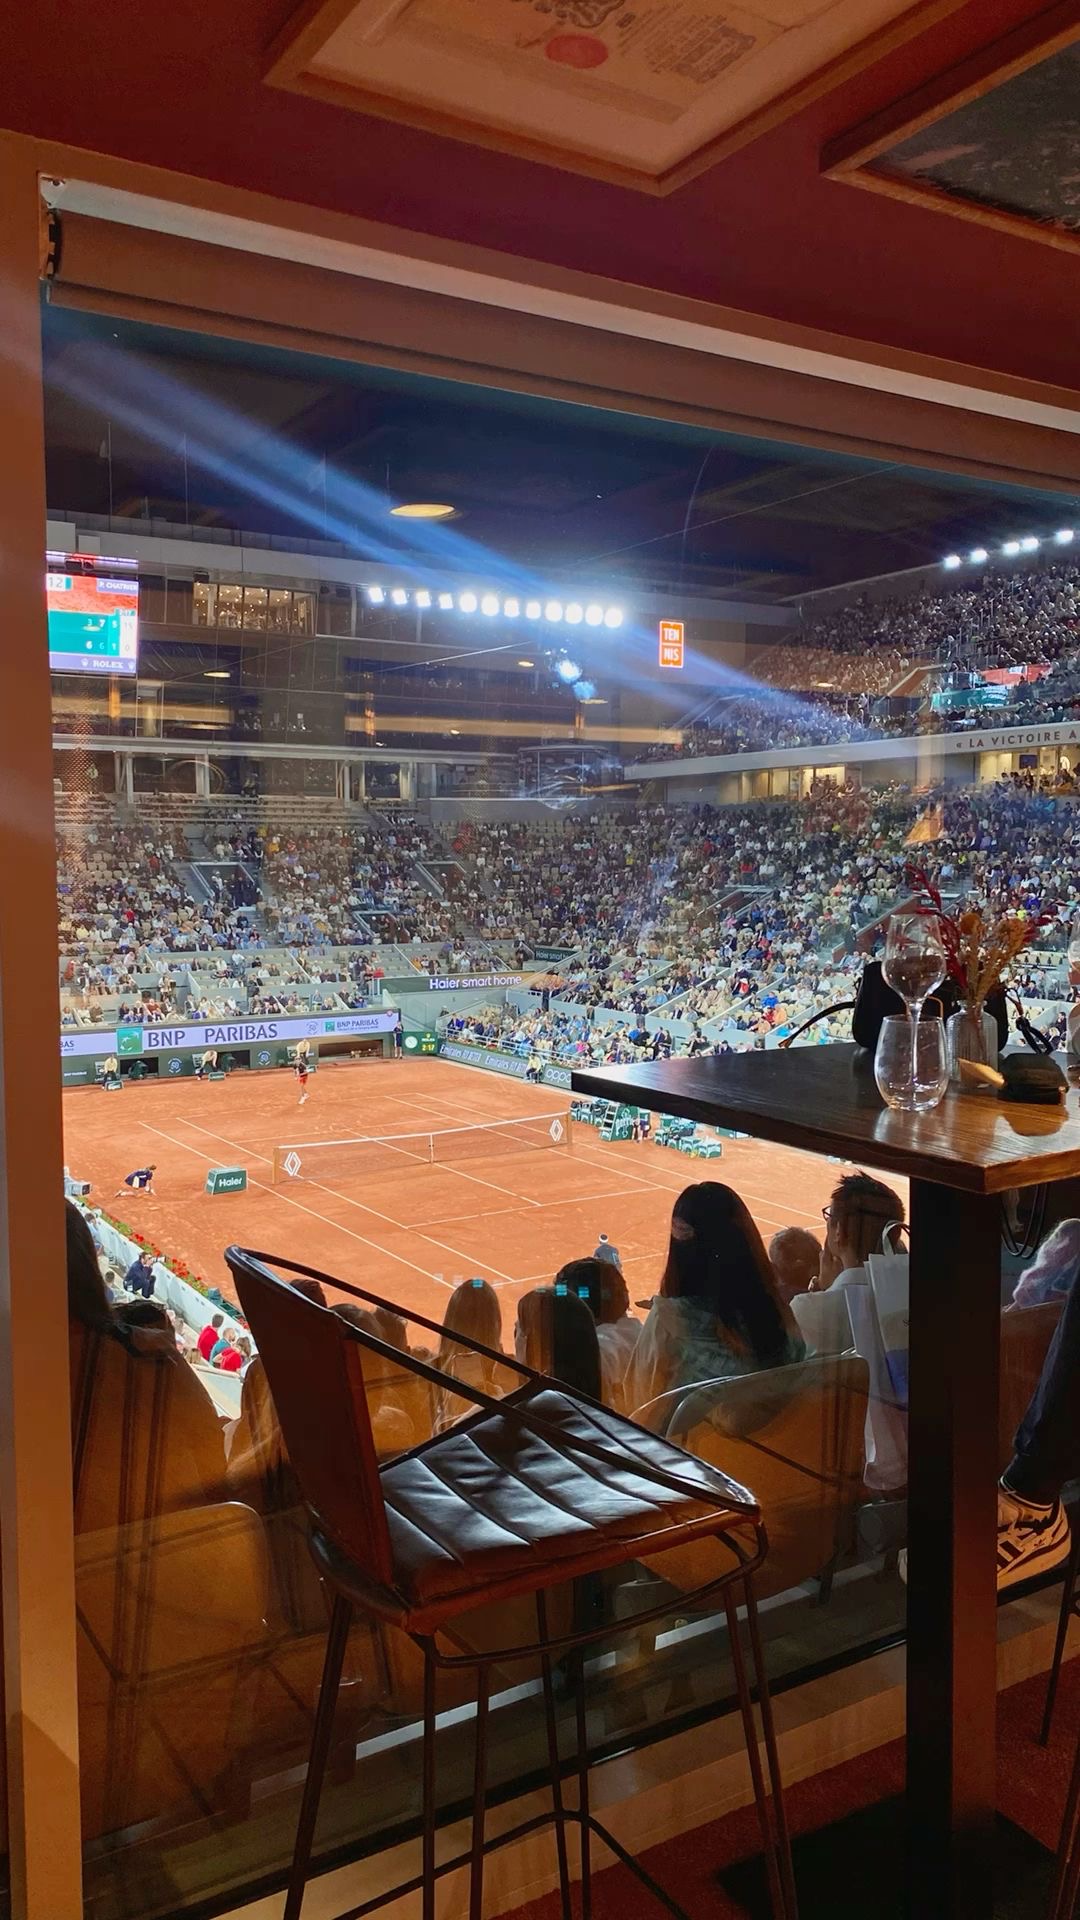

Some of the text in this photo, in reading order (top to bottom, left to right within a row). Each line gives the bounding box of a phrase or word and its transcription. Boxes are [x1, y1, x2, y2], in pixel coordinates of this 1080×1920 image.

[663, 627, 680, 641] TEN
[85, 640, 93, 650] 6
[664, 647, 680, 661] NIS
[93, 659, 124, 669] ROLEX
[969, 738, 984, 749] LA
[991, 731, 1061, 746] VICTOIRE
[1069, 729, 1077, 740] A
[429, 975, 522, 990] Haier smart home
[336, 1021, 350, 1029] BNP
[147, 1023, 279, 1048] BNP PARIBAS
[218, 1177, 243, 1188] Haier
